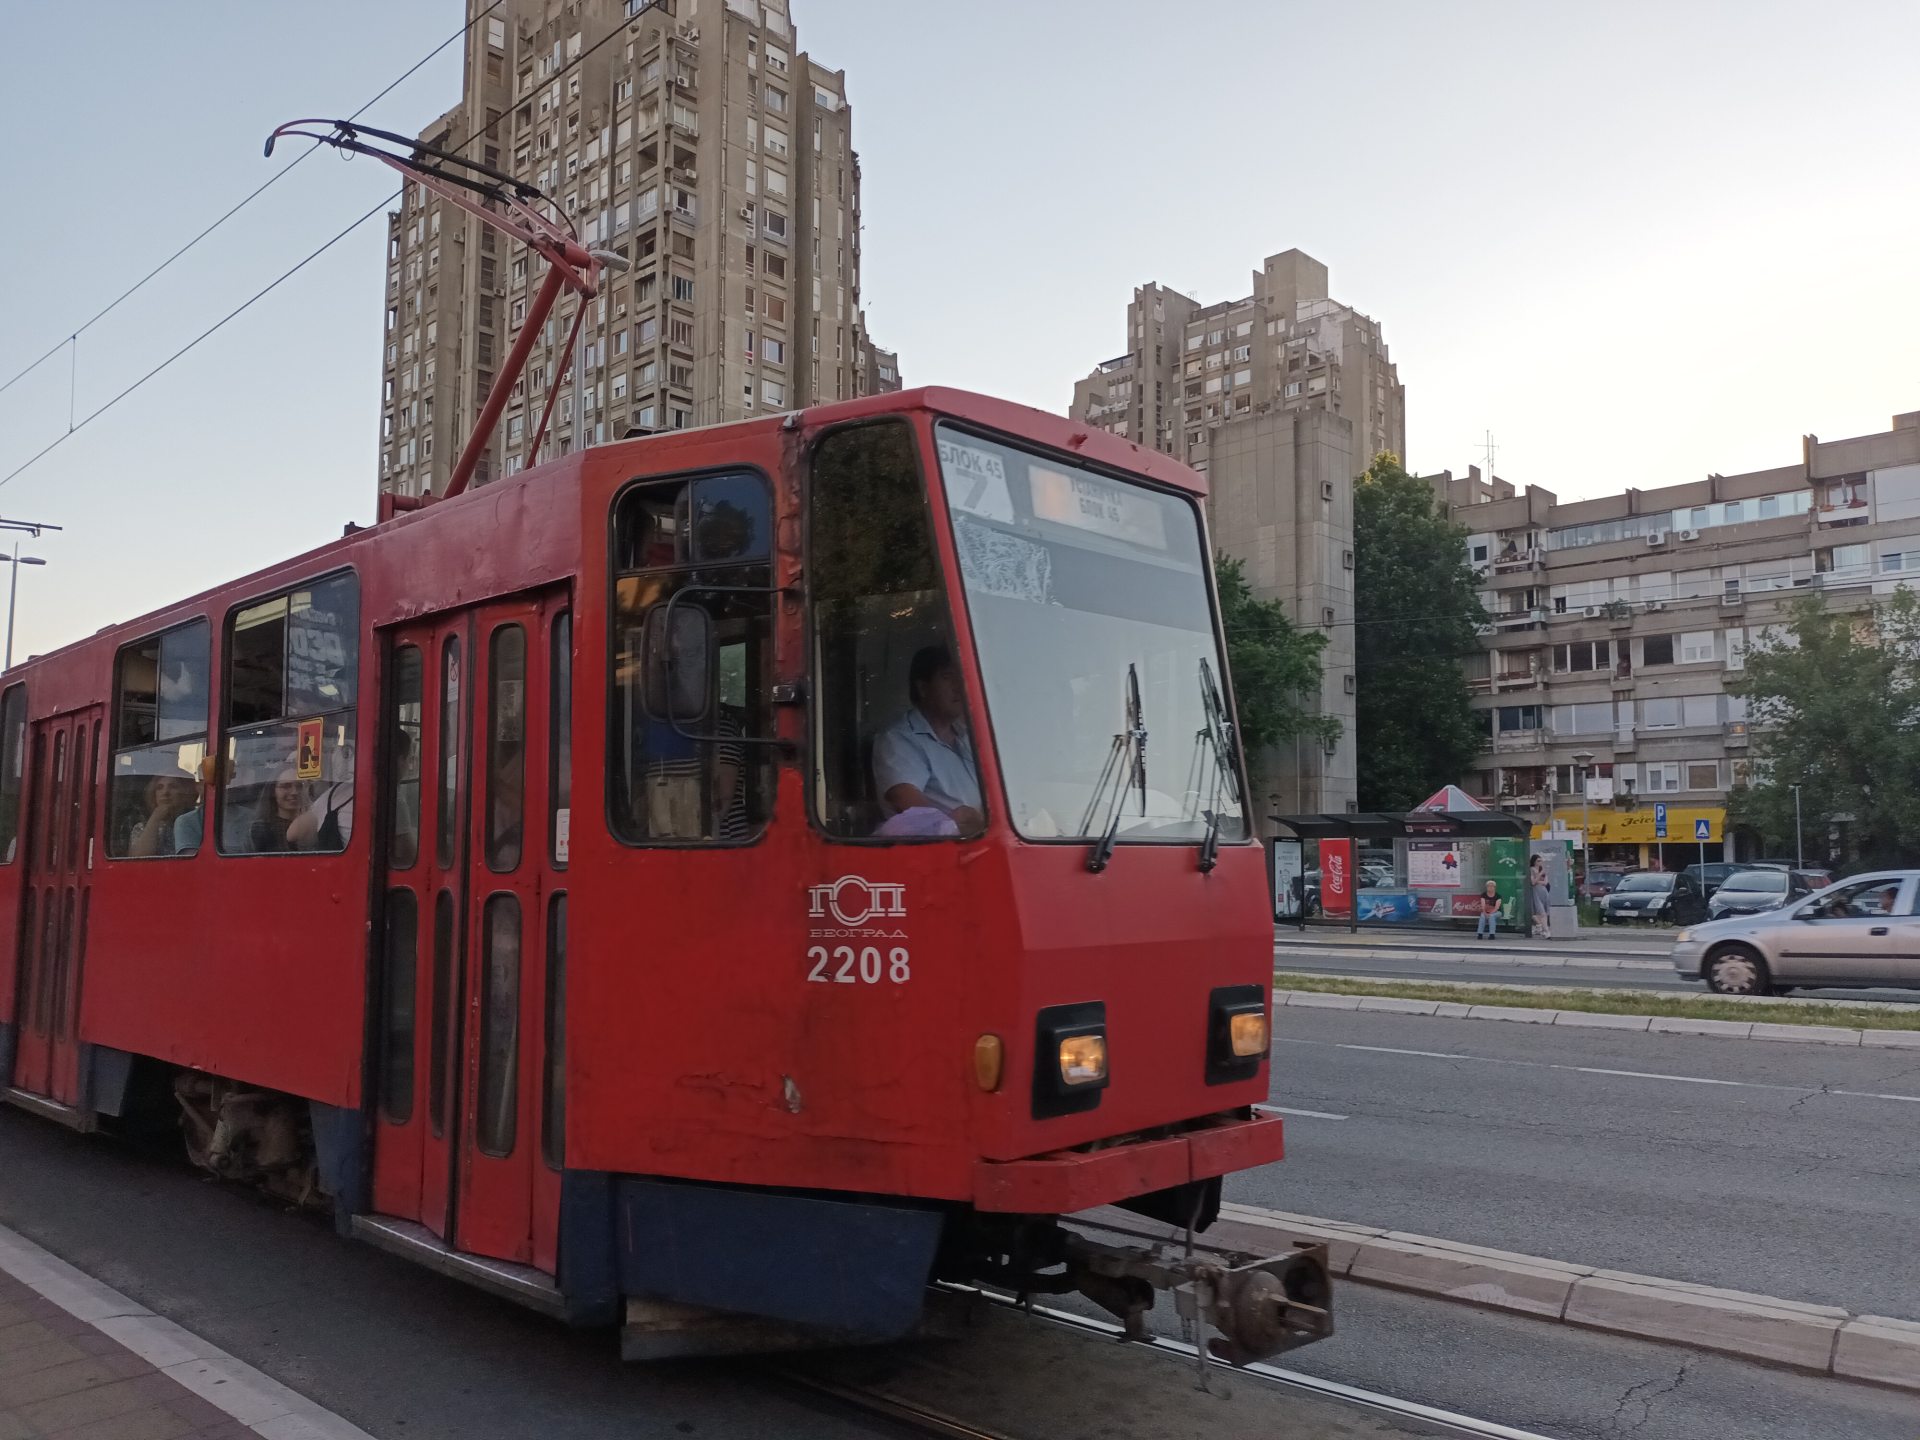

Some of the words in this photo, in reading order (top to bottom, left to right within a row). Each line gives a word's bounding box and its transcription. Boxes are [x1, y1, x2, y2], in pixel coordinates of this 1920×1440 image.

[938, 444, 983, 473] БЛОК
[985, 459, 1003, 480] 45
[955, 467, 988, 510] 7
[1328, 853, 1344, 894] Coca-Cola
[808, 874, 907, 927] ГСП
[809, 928, 908, 939] БЕОГРАД
[807, 945, 910, 984] 2208
